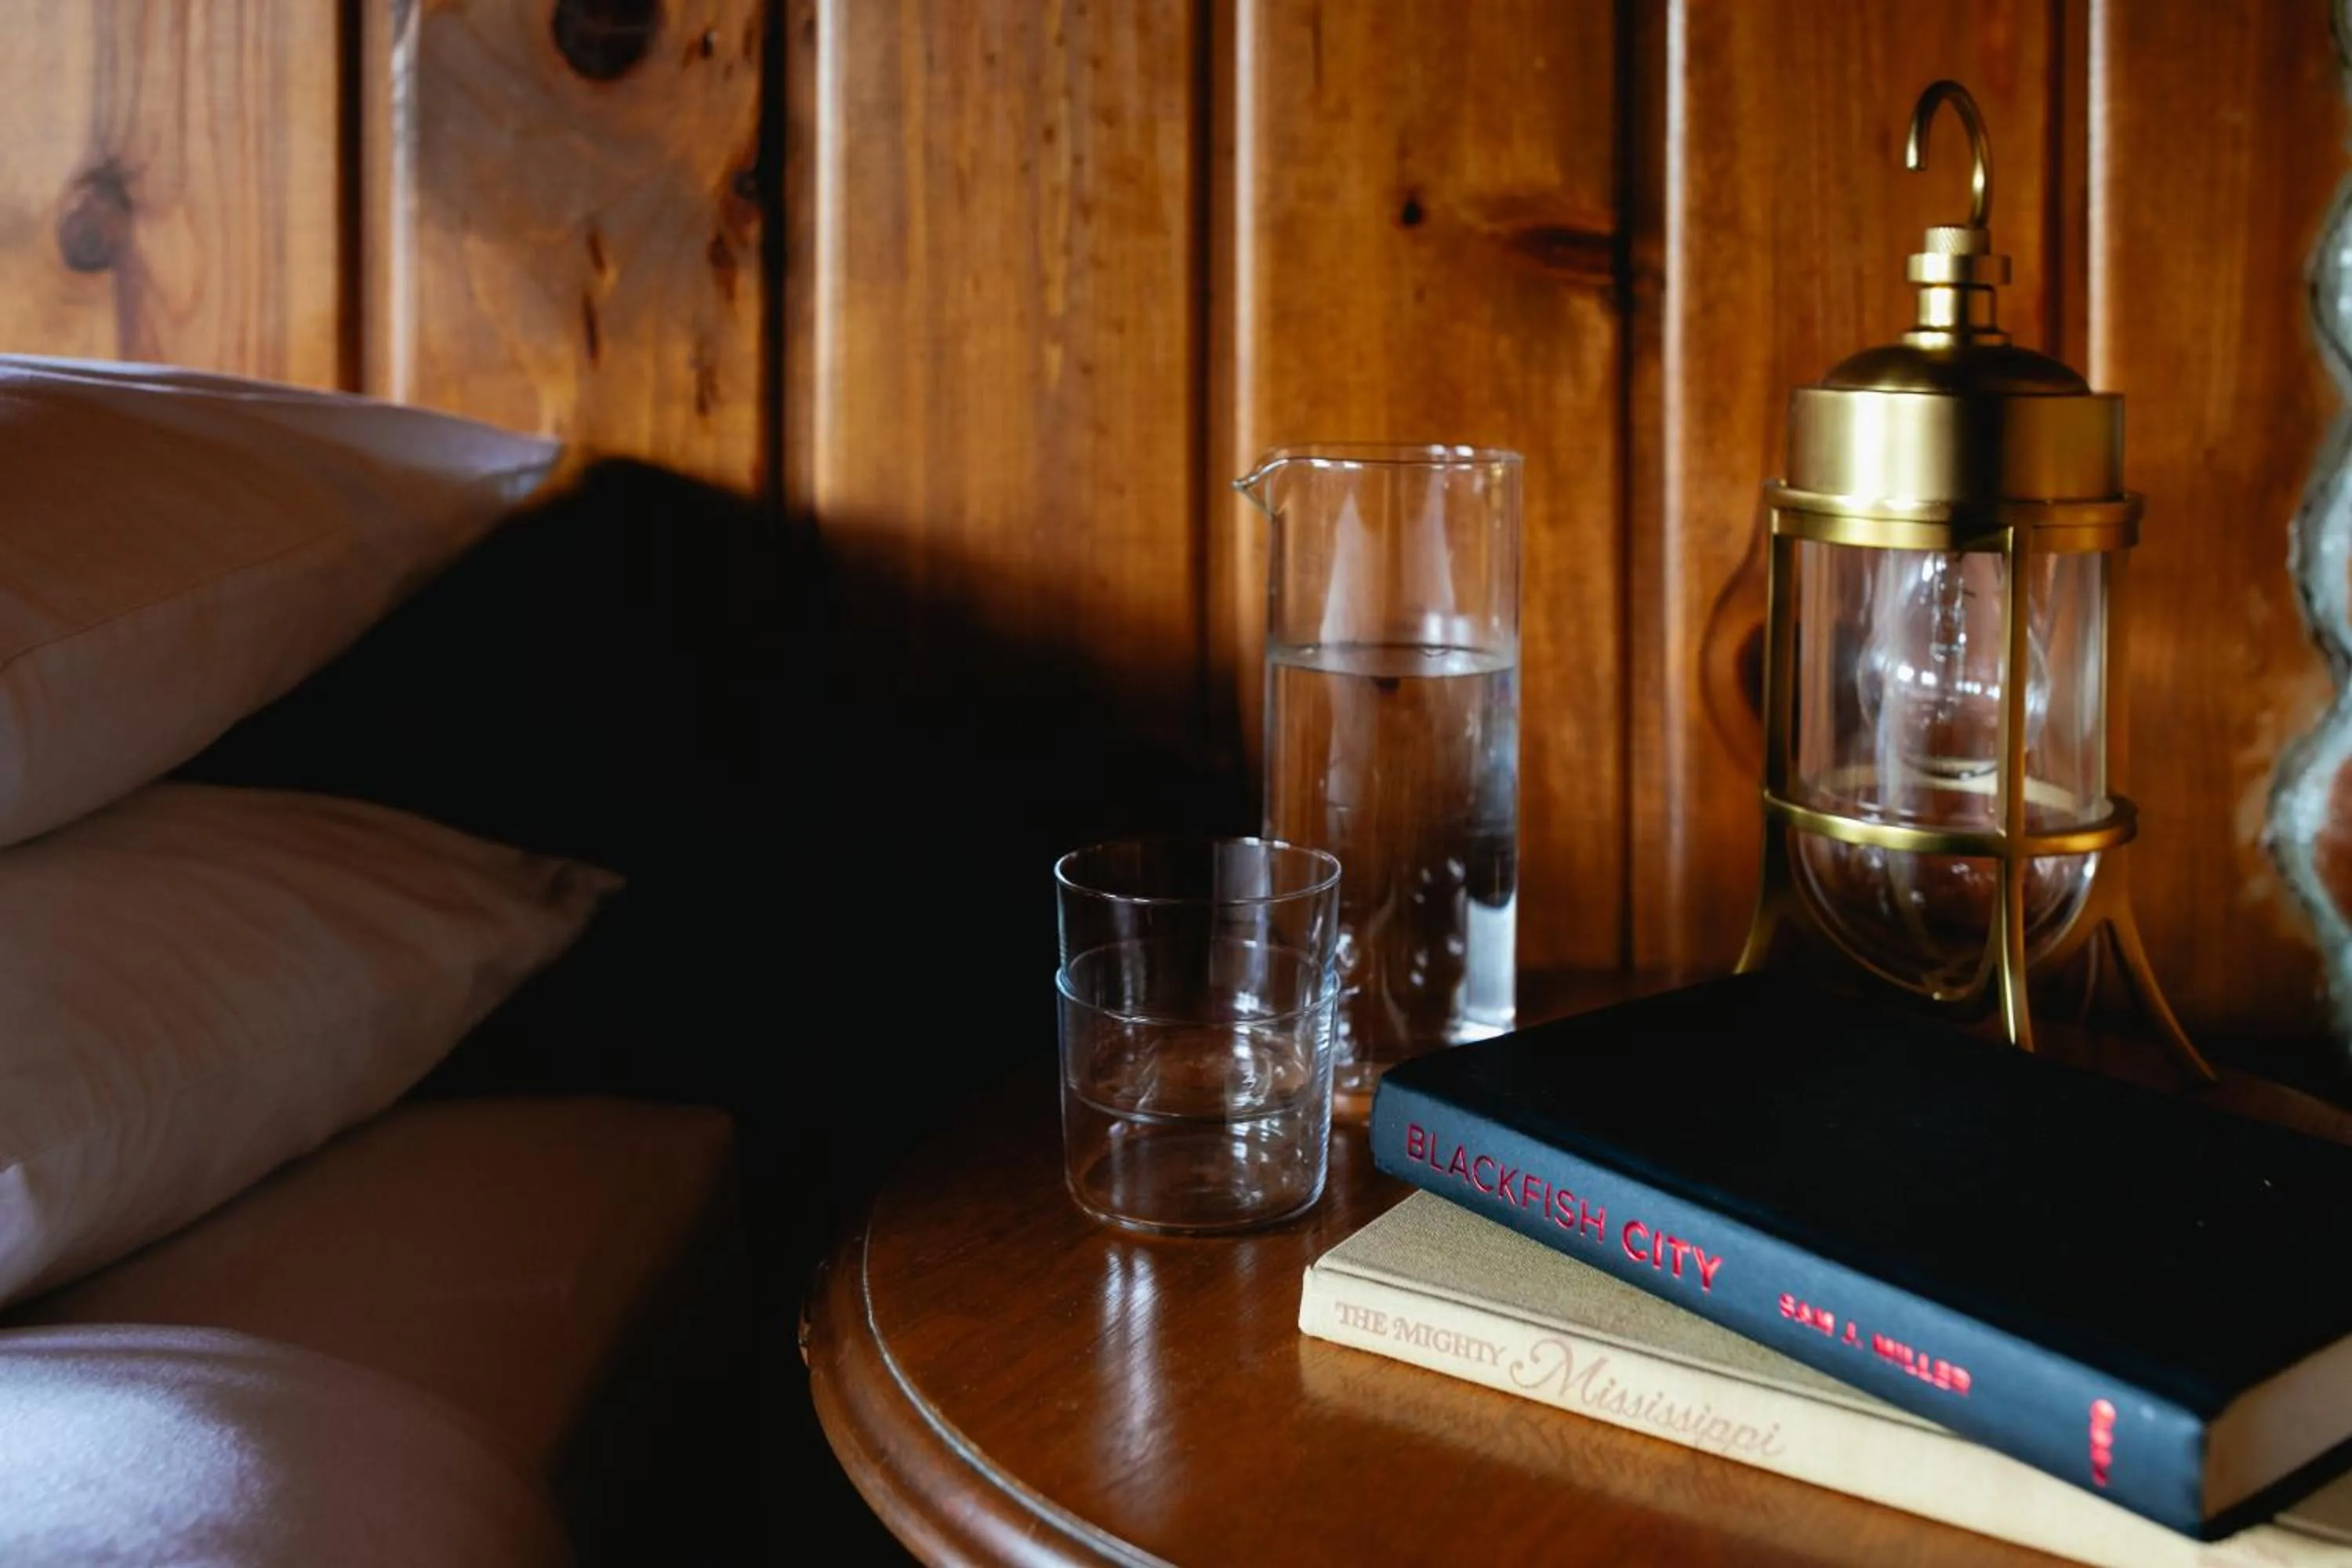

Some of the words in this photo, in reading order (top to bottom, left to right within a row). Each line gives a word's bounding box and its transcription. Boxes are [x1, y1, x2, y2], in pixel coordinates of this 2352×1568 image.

[1406, 1122, 1606, 1243] BLACKFISH
[1621, 1220, 1722, 1293] CITY
[1335, 1301, 1388, 1335] THE
[1392, 1316, 1507, 1367] MIGHTY
[1508, 1336, 1788, 1459] Mississippi
[1778, 1292, 1835, 1337] SAM
[1842, 1321, 1864, 1349] J.
[1871, 1333, 1972, 1396] MILLER
